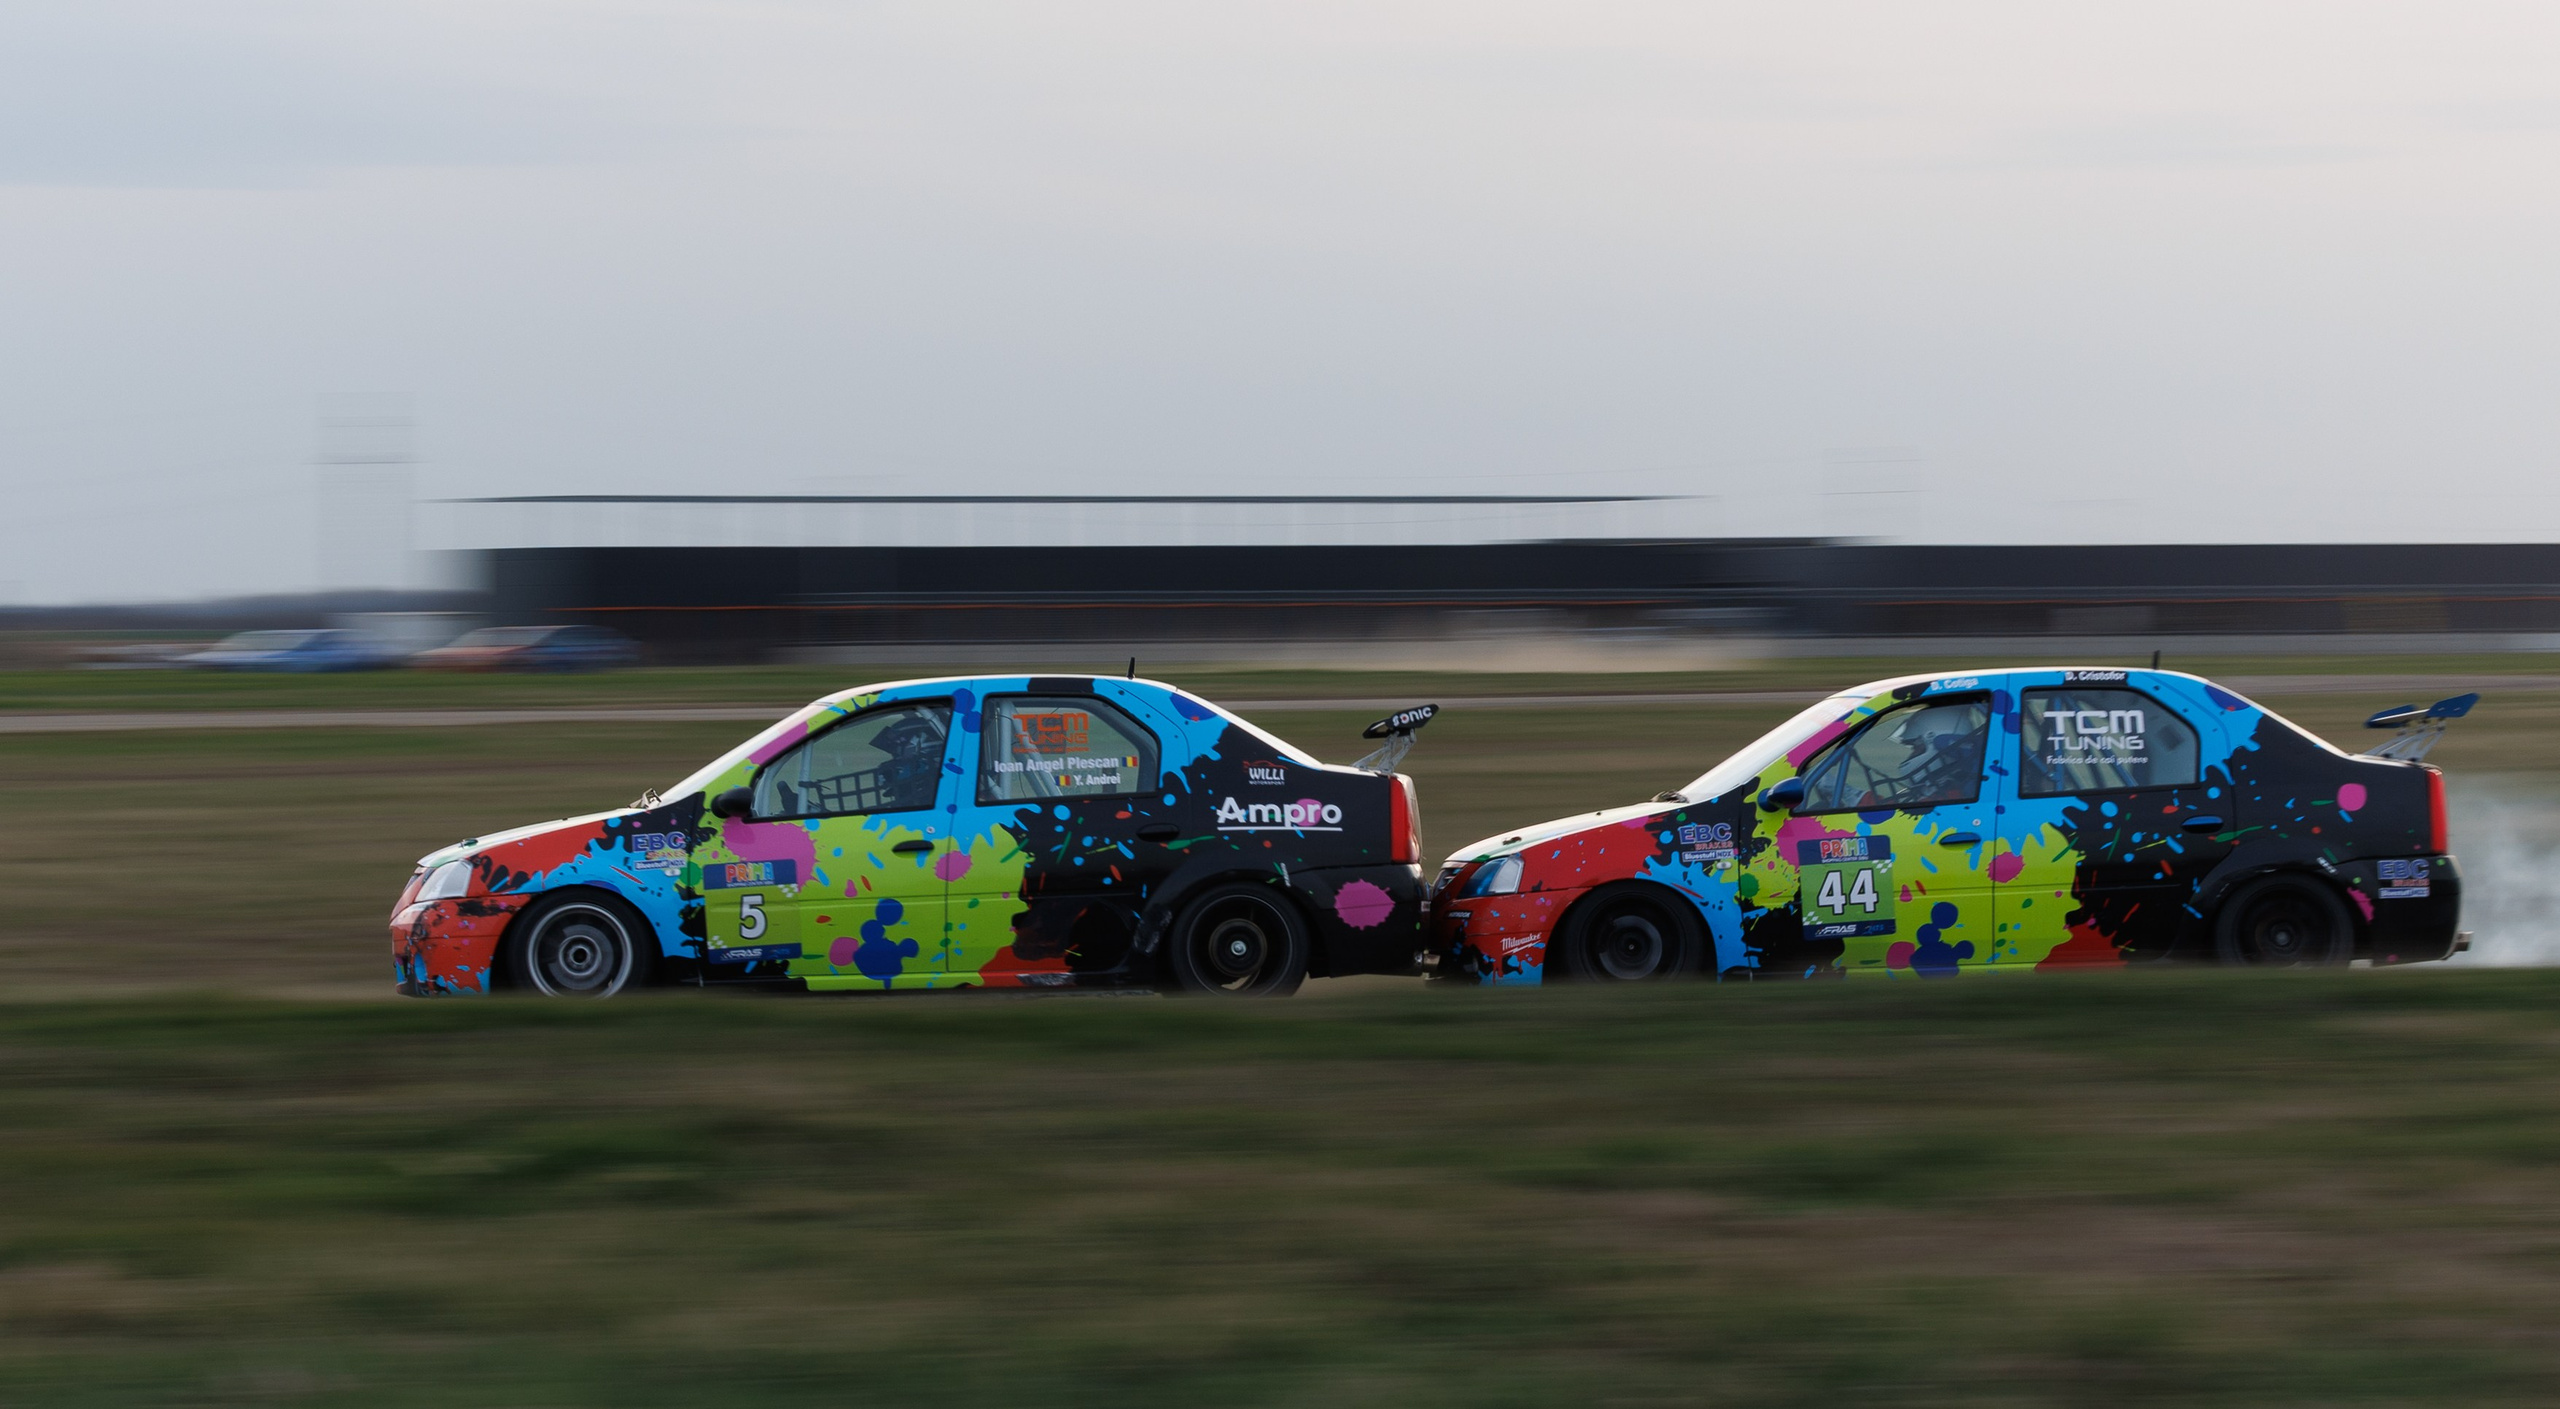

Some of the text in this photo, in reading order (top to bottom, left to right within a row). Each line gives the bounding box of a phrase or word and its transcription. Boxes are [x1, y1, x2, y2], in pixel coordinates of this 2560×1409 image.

[1012, 712, 1089, 732] TCM
[2043, 710, 2145, 734] TCM
[1014, 733, 1089, 744] TUNING
[2047, 735, 2145, 750] TUNING
[994, 756, 1119, 774] Ioan Angel Plescan
[2046, 755, 2083, 765] Fabrica
[2085, 755, 2098, 764] de
[2116, 756, 2148, 766] putere
[1073, 772, 1121, 786] Y. Andrei
[1248, 767, 1285, 781] WILLI
[1216, 797, 1343, 828] Ampro
[631, 831, 687, 853] EBC
[1678, 822, 1733, 845] EBC
[2377, 858, 2430, 880] EBC
[1817, 867, 1879, 916] 44
[739, 893, 768, 940] 5
[1499, 932, 1542, 951] Milwaukee
